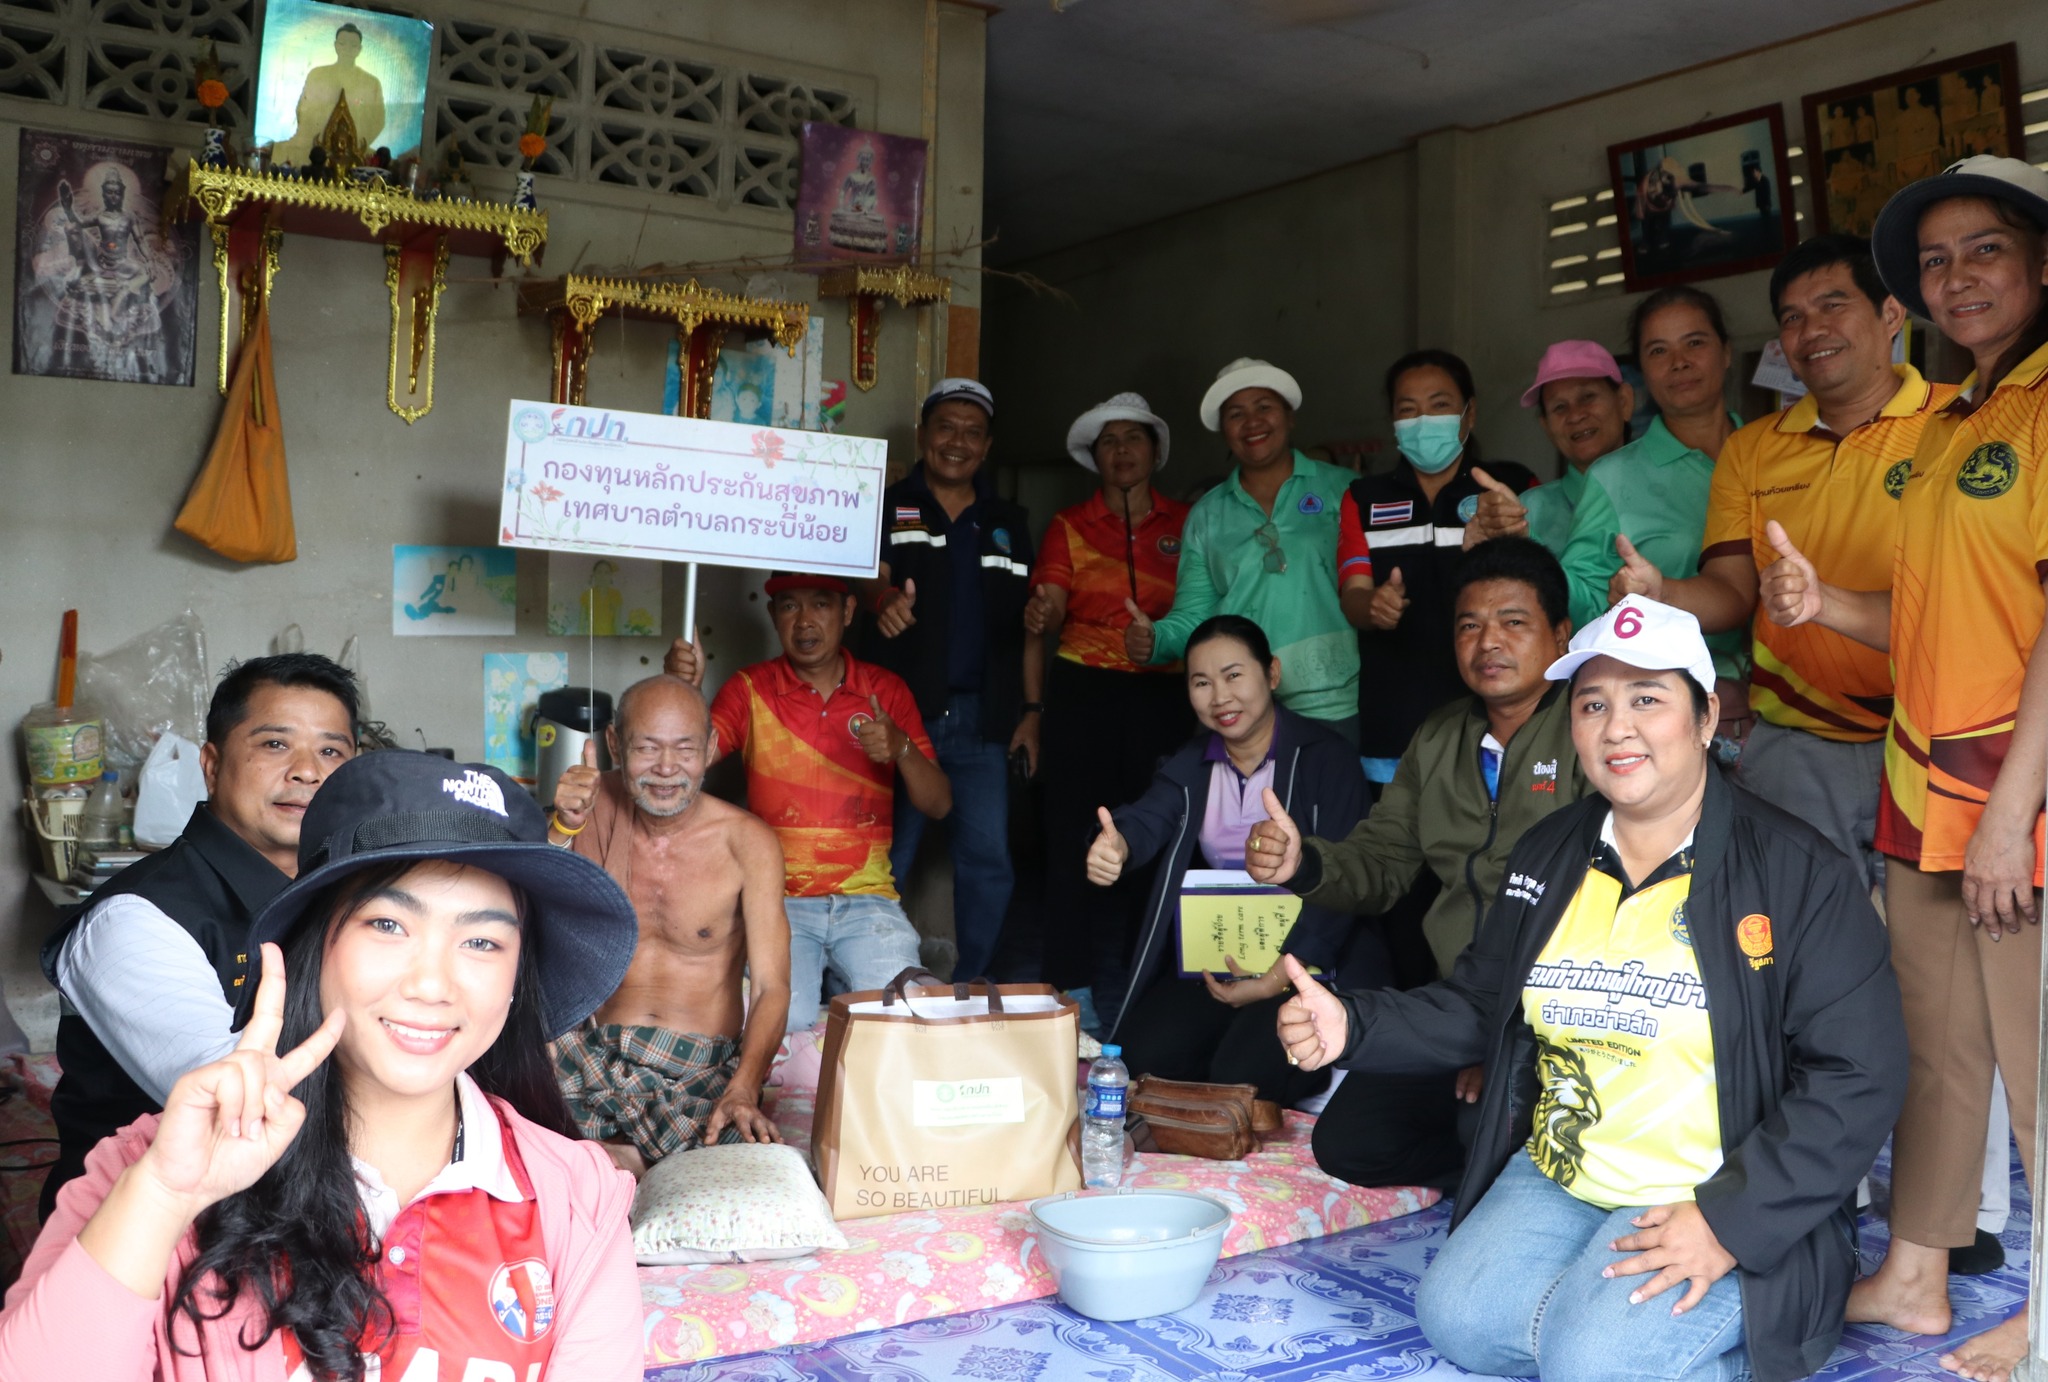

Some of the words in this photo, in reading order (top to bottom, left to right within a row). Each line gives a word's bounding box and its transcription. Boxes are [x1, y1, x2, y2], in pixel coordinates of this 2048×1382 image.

[543, 458, 861, 513] กองทุนหลักประกันสุขภาพ
[563, 499, 849, 544] เทศบาลตำบลกระบี่น้อย
[1614, 606, 1644, 639] 6
[443, 778, 490, 799] NORTH
[464, 770, 492, 787] THE
[1238, 943, 1248, 960] Long
[1542, 999, 1659, 1038] อำเภออ่าวลึก
[1565, 1036, 1604, 1046] LIMITED
[1606, 1040, 1642, 1057] EDITION
[859, 1164, 900, 1183] YOU
[907, 1164, 949, 1182] ARE
[856, 1188, 886, 1208] SO
[893, 1186, 1004, 1209] BEAUTIFUL
